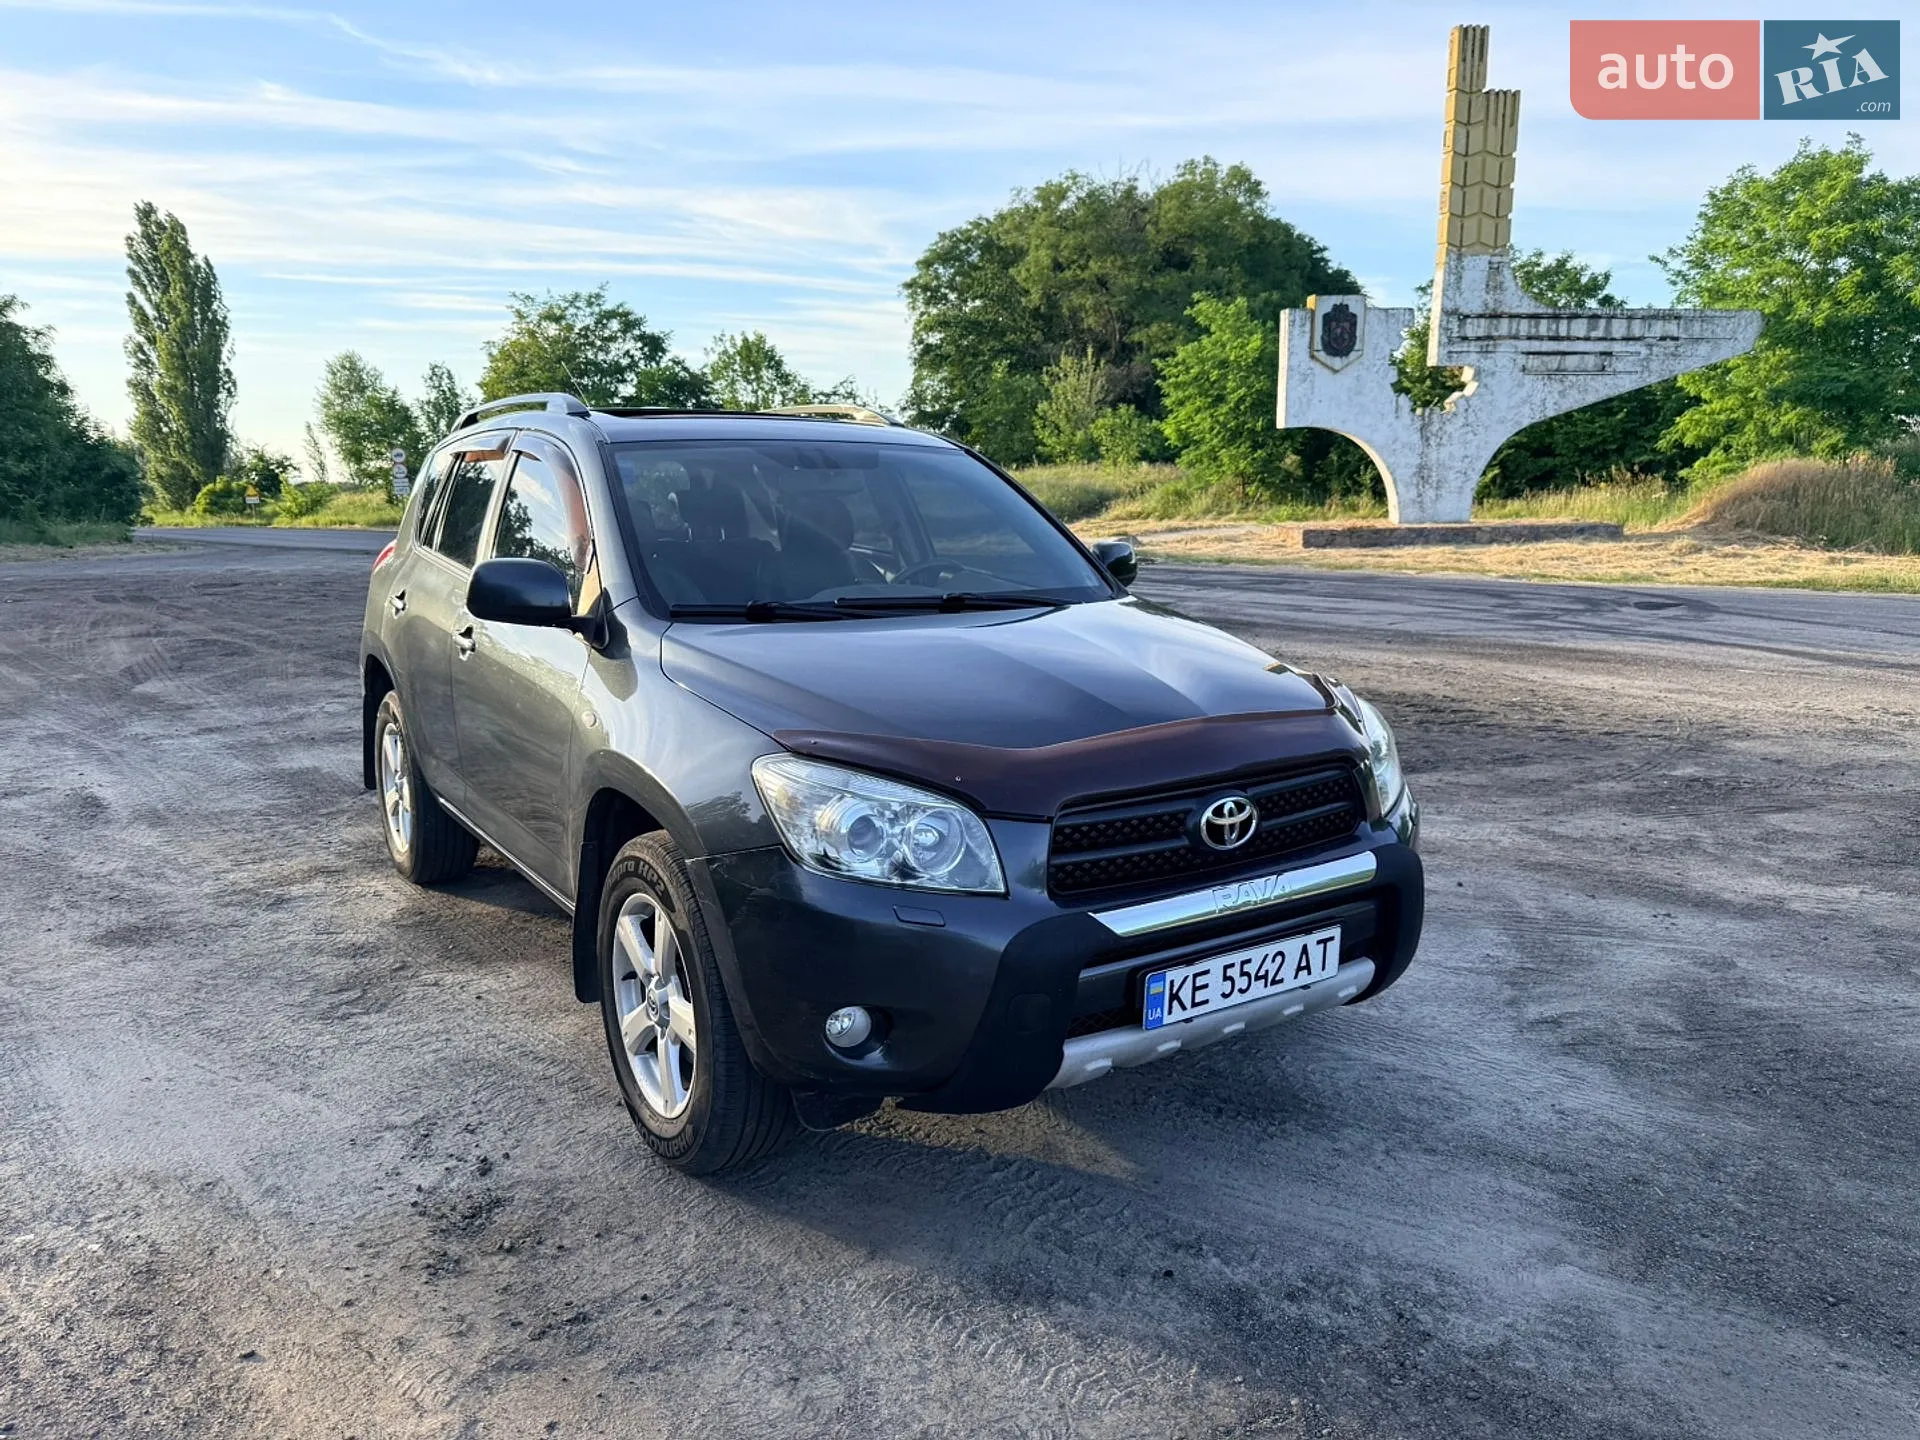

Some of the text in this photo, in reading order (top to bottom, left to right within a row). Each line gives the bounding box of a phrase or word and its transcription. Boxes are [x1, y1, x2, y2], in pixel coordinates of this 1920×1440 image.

[1167, 936, 1335, 1016] KE 5542 AT
[1147, 1007, 1162, 1021] UA
